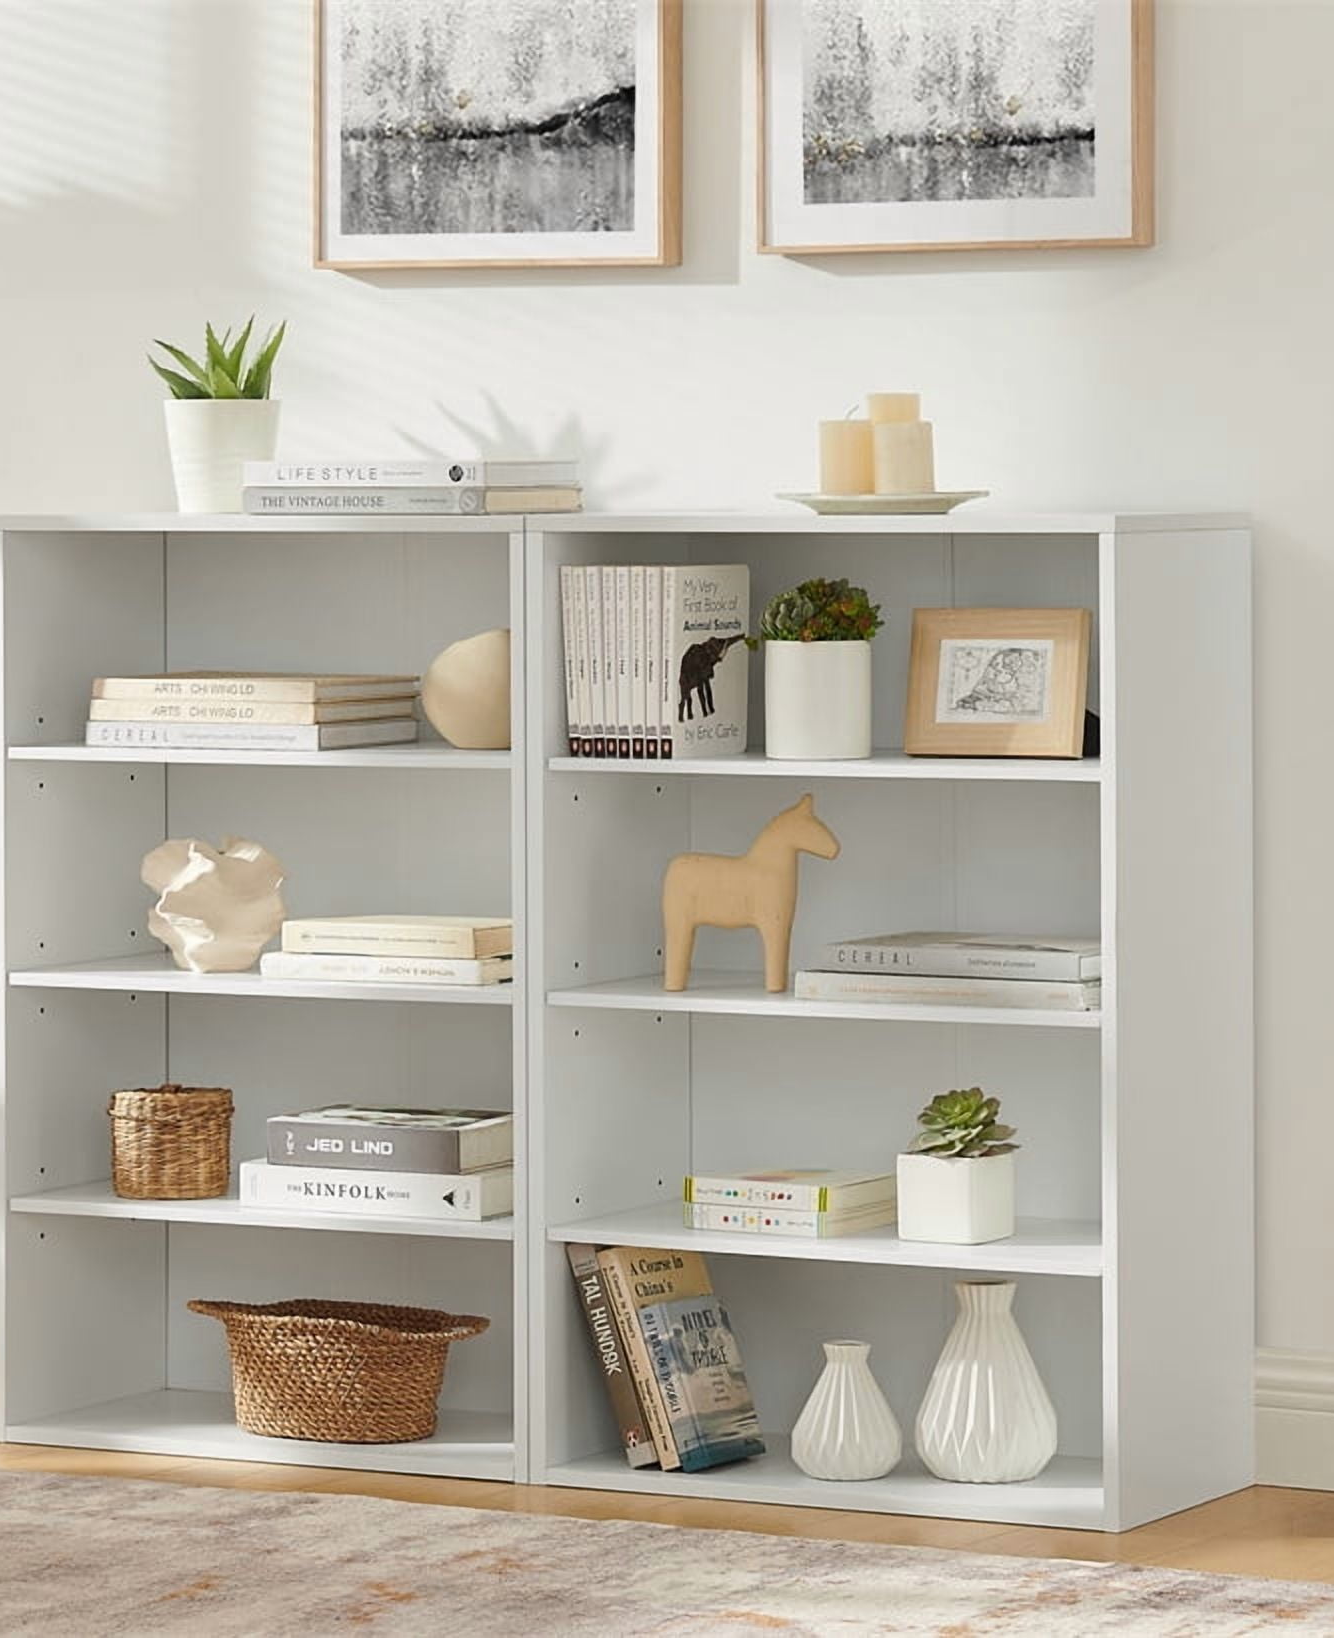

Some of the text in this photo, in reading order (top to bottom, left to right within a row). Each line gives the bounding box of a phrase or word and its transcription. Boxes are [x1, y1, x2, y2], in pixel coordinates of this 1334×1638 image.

[260, 495, 385, 508] THE VINTAGE HOUSE
[305, 1137, 394, 1156] JED LIND
[303, 1182, 386, 1201] KINFOLK
[629, 1261, 639, 1277] A
[580, 1274, 602, 1305] TAL
[634, 1278, 675, 1298] China's
